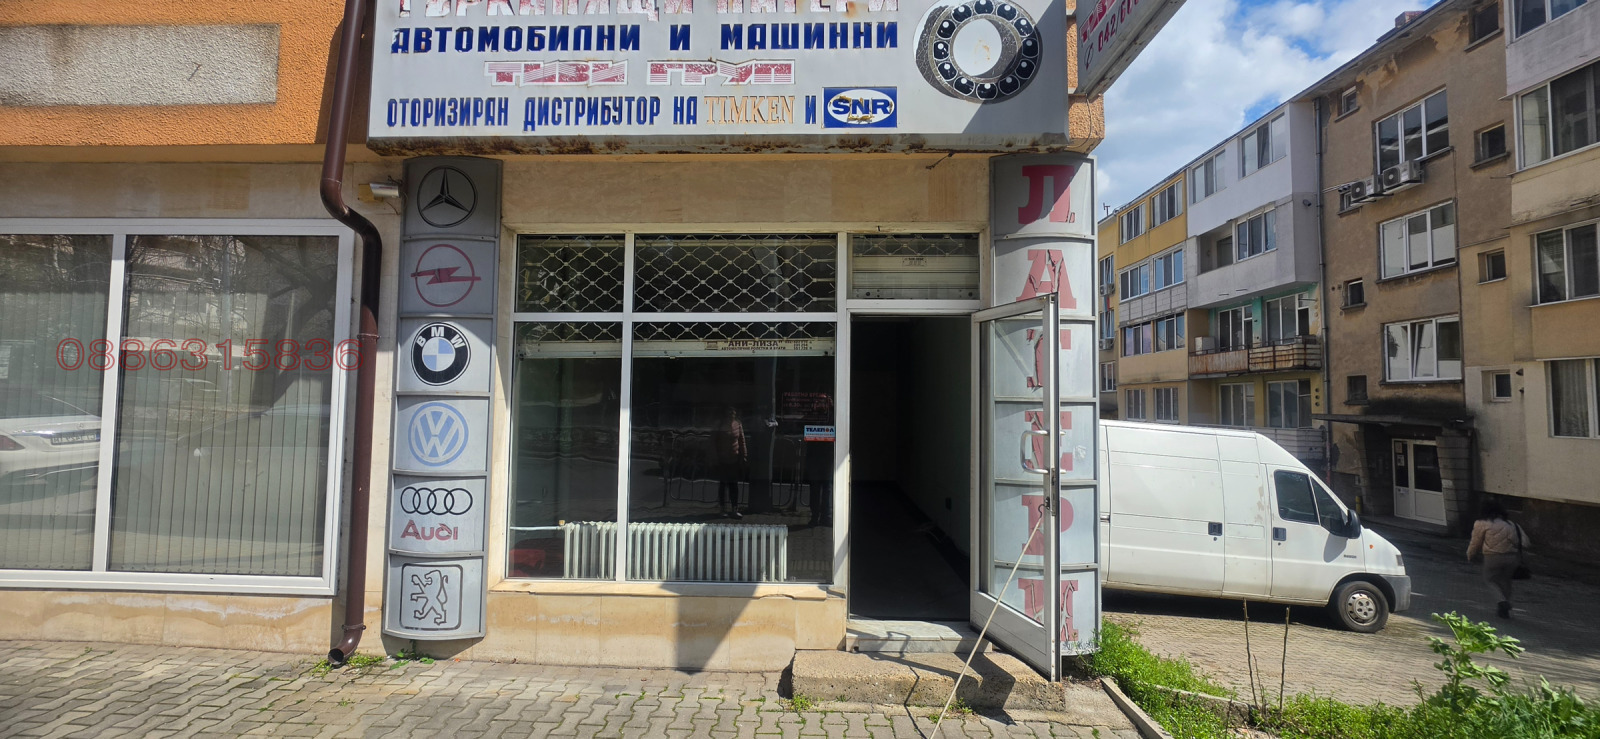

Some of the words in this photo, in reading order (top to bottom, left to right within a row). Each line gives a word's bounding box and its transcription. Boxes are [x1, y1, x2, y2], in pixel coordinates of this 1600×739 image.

[391, 24, 641, 54] АВТОМОБИЛНИ
[669, 24, 692, 51] И
[720, 22, 898, 50] МАШИННИ
[387, 97, 509, 127] ОТОРИЗИРАН
[523, 96, 661, 132] ДИСТРИБУТОР
[673, 96, 698, 125] НА
[704, 95, 795, 125] TIMKEN
[805, 96, 817, 125] И
[832, 97, 890, 115] SNR
[417, 326, 466, 349] BMW
[400, 519, 459, 541] Audi
